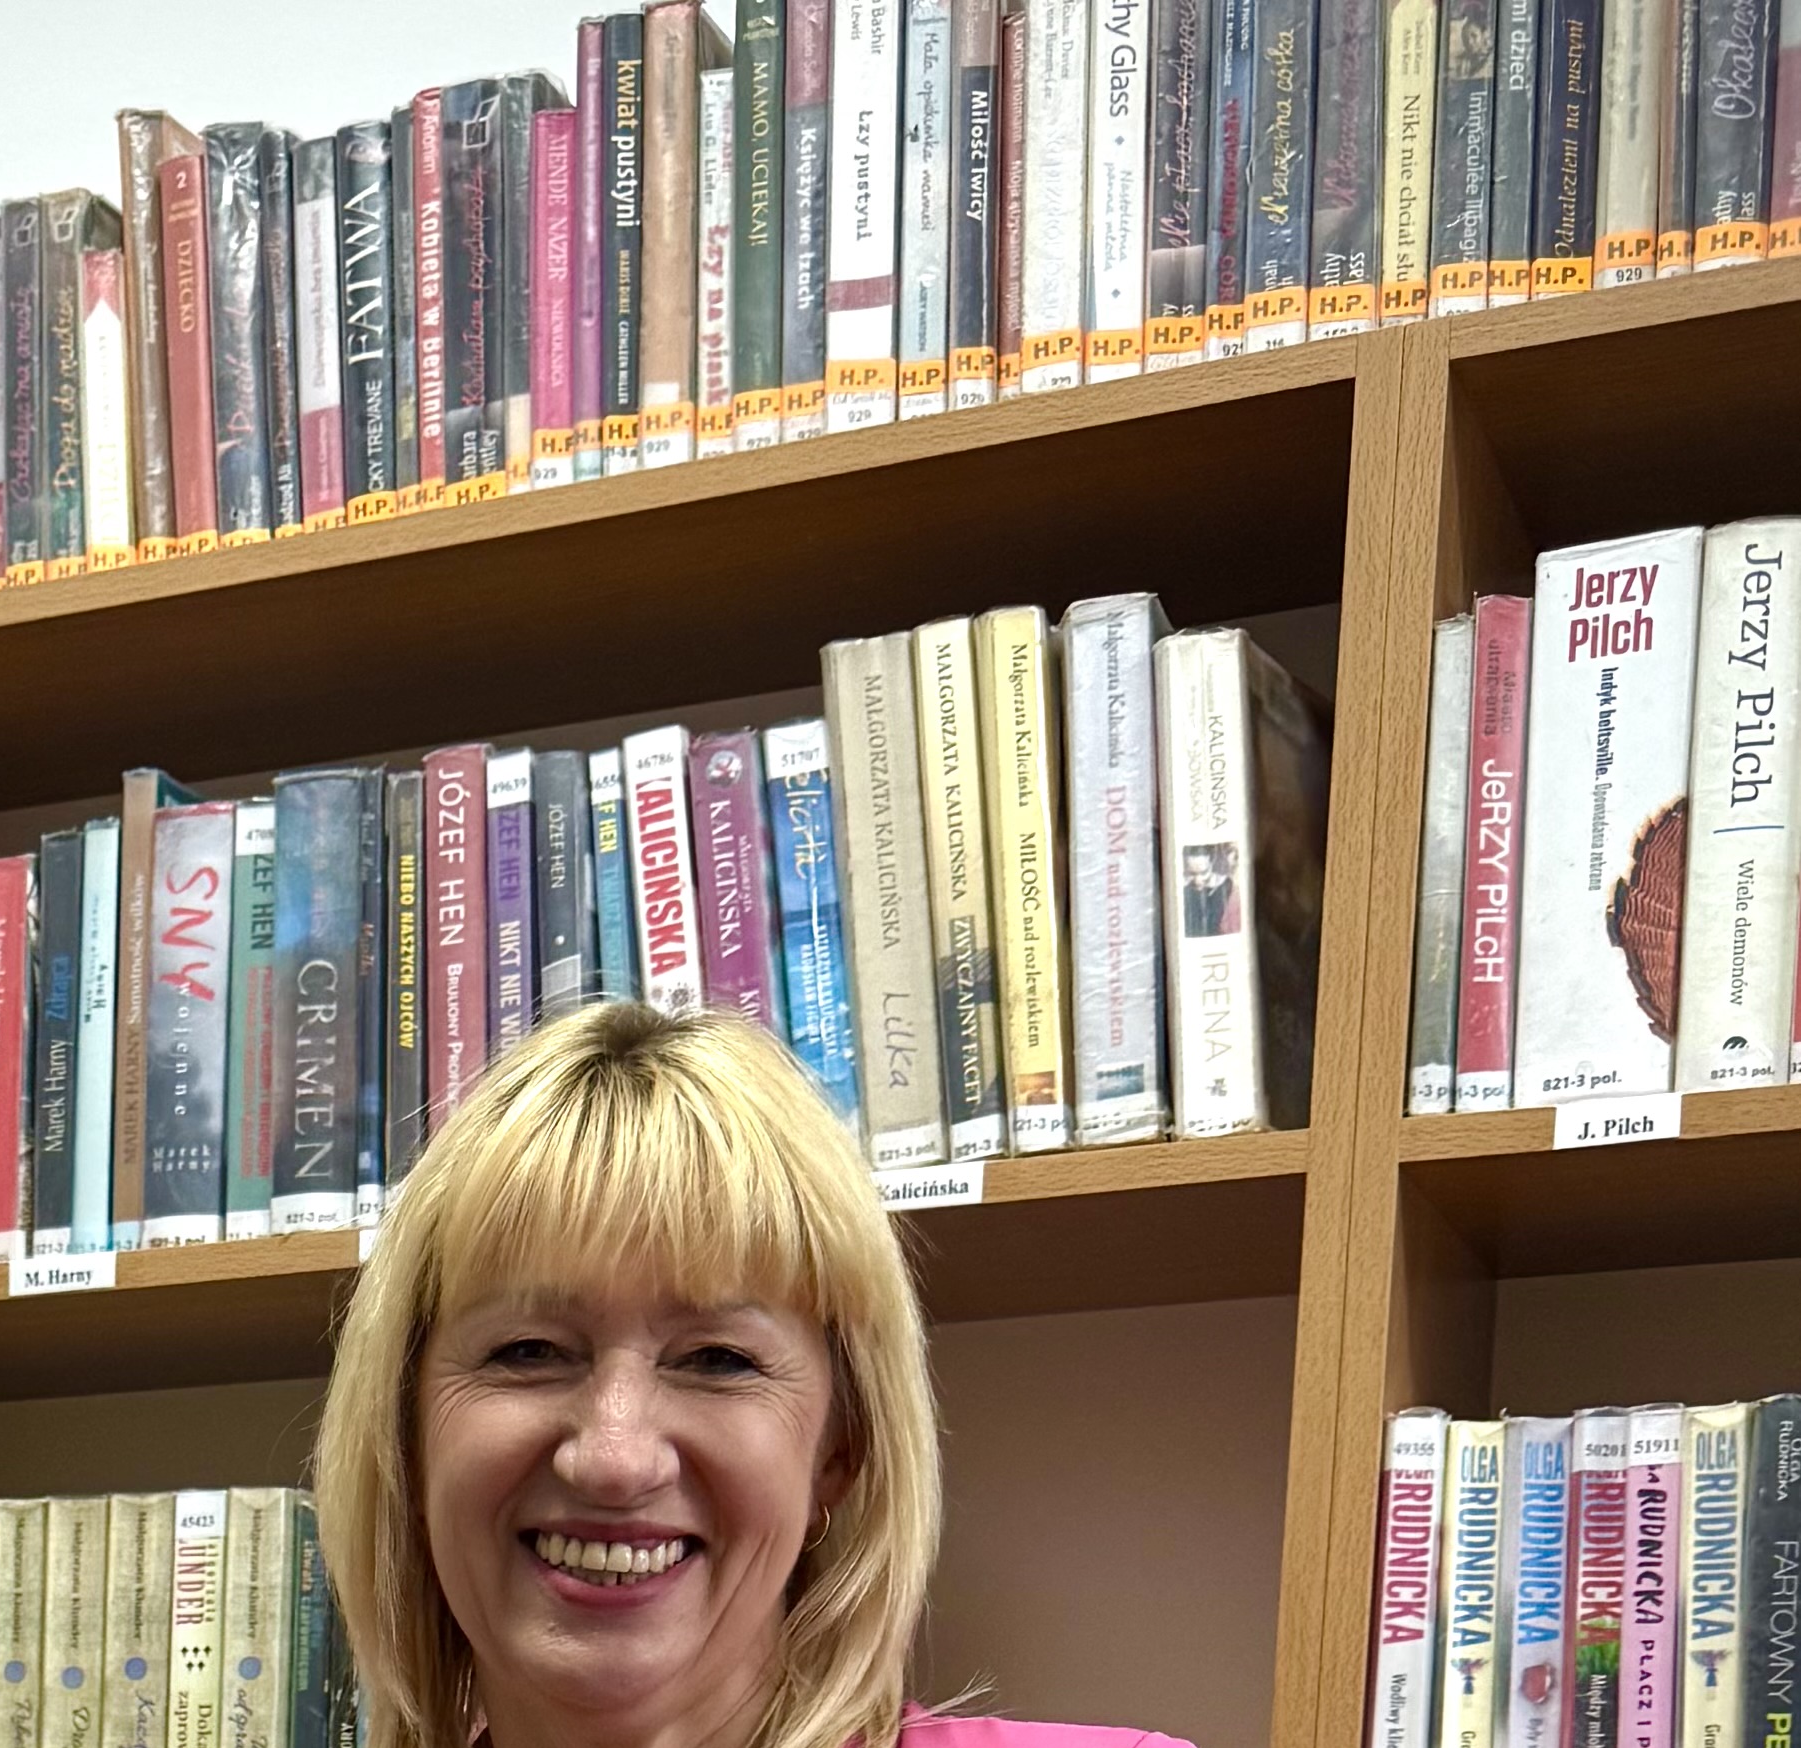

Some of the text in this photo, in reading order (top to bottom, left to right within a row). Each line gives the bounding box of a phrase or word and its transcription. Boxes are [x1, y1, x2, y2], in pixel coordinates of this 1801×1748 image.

[1108, 43, 1138, 120] Glass
[1510, 28, 1530, 93] dzieci
[750, 62, 769, 139] MAMO,
[970, 89, 988, 163] Miłość
[1402, 94, 1422, 142] Nikt
[175, 171, 188, 189] 2
[610, 58, 641, 229] kwiat pustyni
[1403, 146, 1416, 183] nie
[546, 133, 569, 281] MENDE NAZER
[853, 154, 874, 243] pustyni
[174, 237, 196, 337] DZIECKO
[344, 180, 385, 366] FATWA
[1252, 297, 1301, 319] H.P.
[1616, 267, 1643, 283] 929
[839, 368, 886, 387] H.P.
[1093, 338, 1141, 357] H.P.
[365, 379, 384, 458] TREVANE
[455, 483, 498, 506] H.P.
[1568, 563, 1660, 613] Jerzy
[1567, 608, 1654, 664] Pilch
[1727, 541, 1784, 809] Jerzy Pilch
[436, 767, 472, 864] JÓZEF
[547, 803, 566, 889] JÓZEF HEN
[399, 853, 416, 906] NIEBO
[438, 878, 465, 947] HEN
[708, 800, 744, 958] KALICIŃSKA
[159, 865, 220, 1002] SNY
[399, 910, 416, 988] NASZYCH
[500, 919, 521, 1011] NIKT NIE
[1728, 859, 1756, 1007] Wiele demonów
[880, 990, 917, 1089] Lilka
[1201, 951, 1234, 1064] IRENA
[293, 958, 338, 1181] CRIMEN
[1591, 1071, 1623, 1091] pol.
[1577, 1114, 1655, 1142] J. Pilch
[24, 1267, 94, 1288] M. Harny
[1461, 1443, 1500, 1485] OLGA
[1382, 1482, 1433, 1645] RUDNICKA
[1452, 1488, 1499, 1648] RUDNICKA
[1517, 1482, 1565, 1646] RUDNICKA
[1635, 1490, 1667, 1626] RUDNICKA
[1691, 1474, 1738, 1642] RUDNICKA
[1771, 1539, 1799, 1704] FARTOWNY
